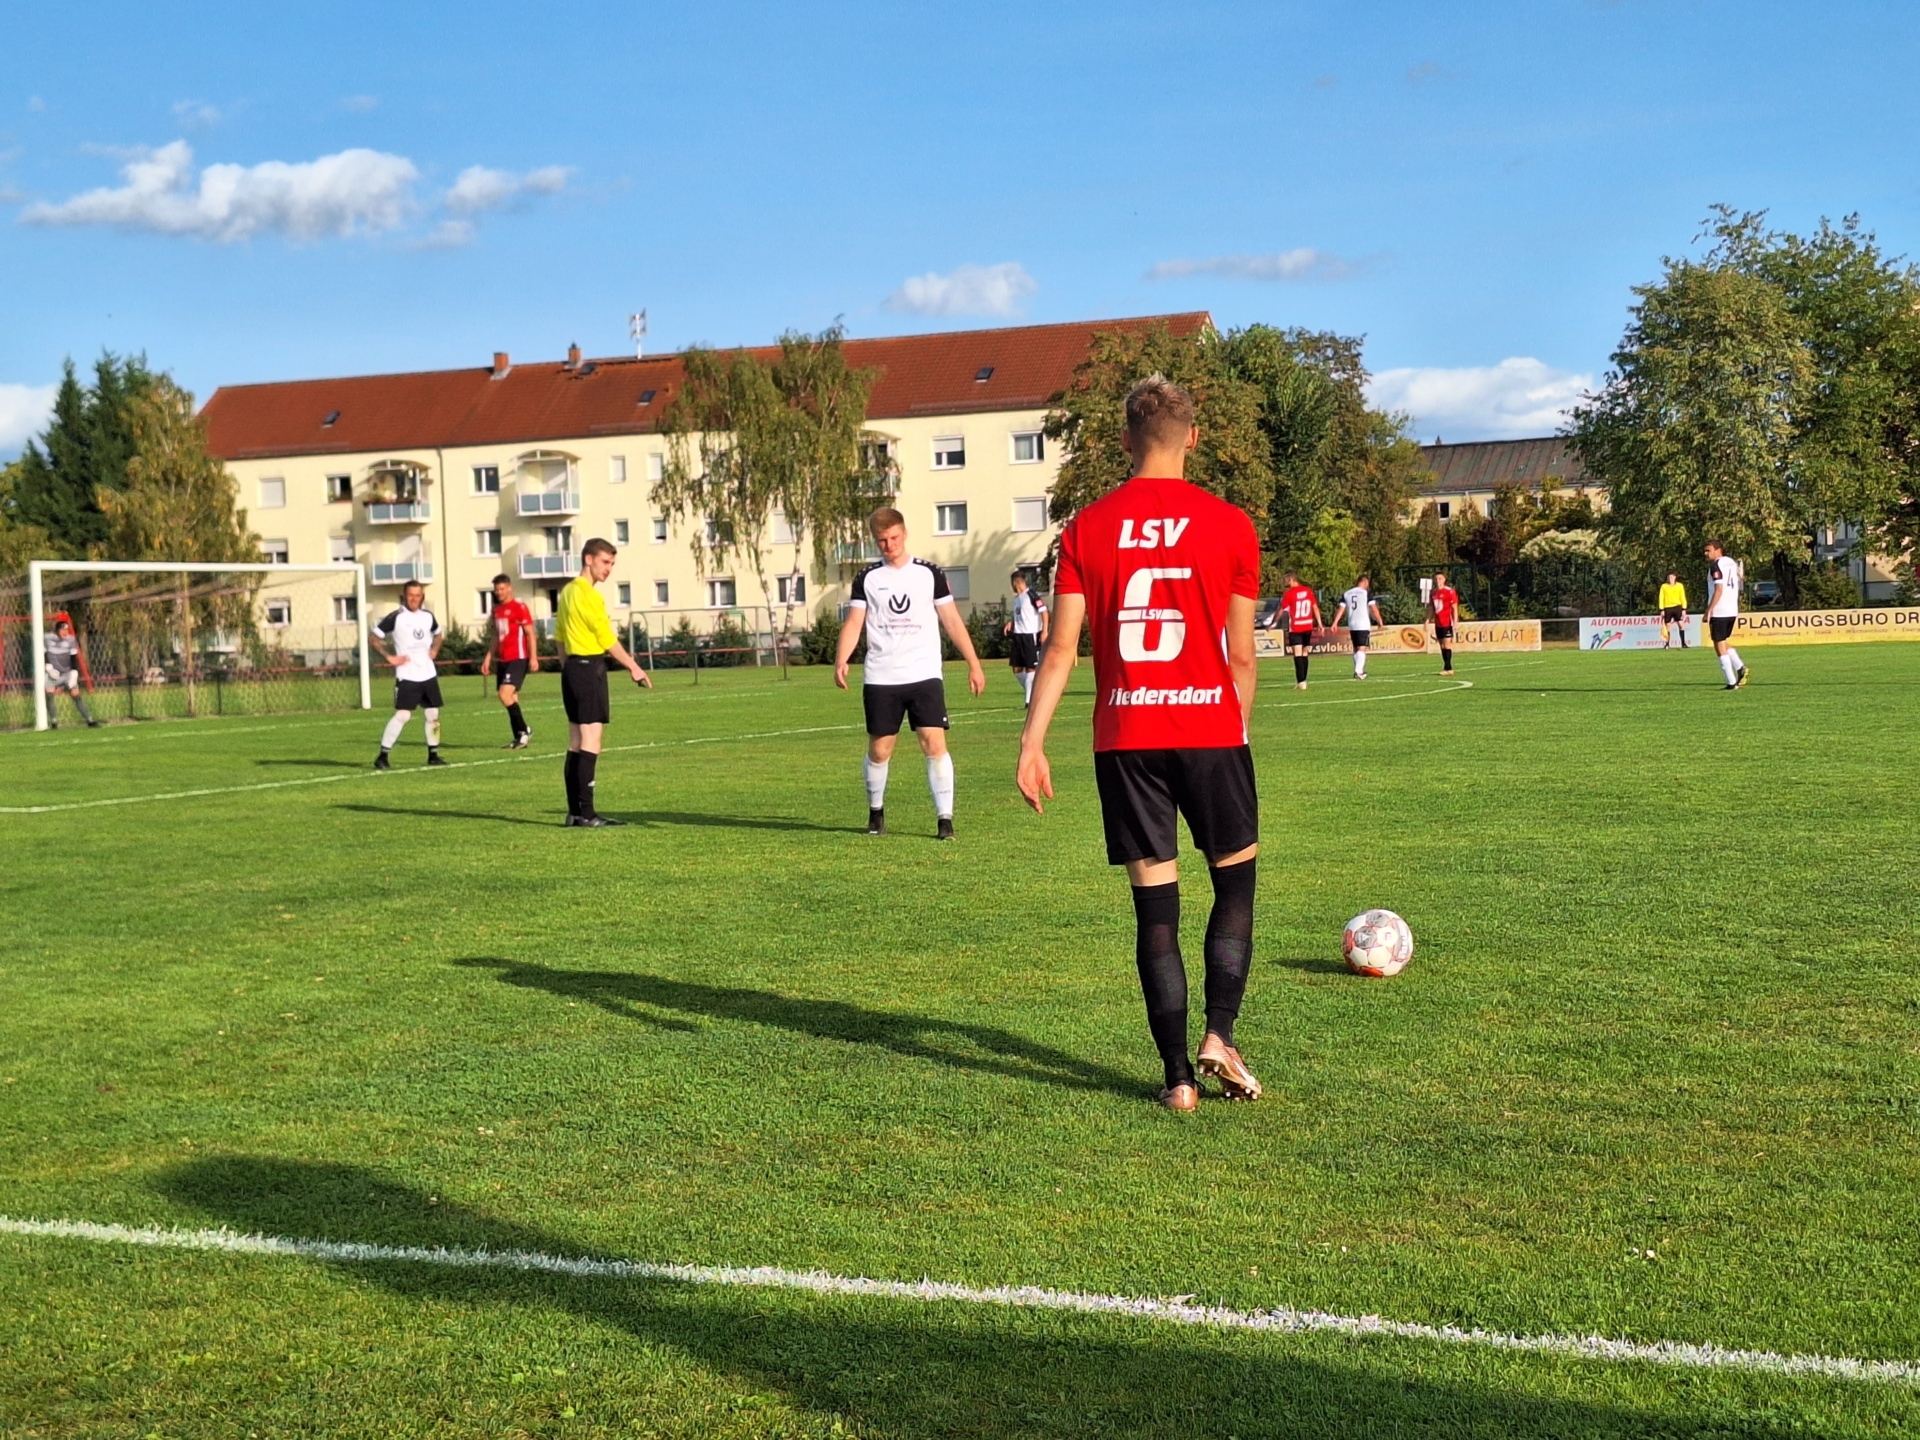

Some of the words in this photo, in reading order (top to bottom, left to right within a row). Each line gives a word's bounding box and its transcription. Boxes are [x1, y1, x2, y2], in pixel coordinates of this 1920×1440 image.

[1118, 518, 1190, 549] LSV
[1727, 569, 1735, 590] 4
[1295, 600, 1311, 618] 10
[1351, 596, 1358, 611] 5
[1118, 568, 1192, 662] 6
[1141, 609, 1163, 620] LSV
[1590, 617, 1647, 627] AUTOHAUS
[1738, 611, 1889, 629] PLANUNGSBÜRO
[1108, 686, 1223, 706] iedersdorf
